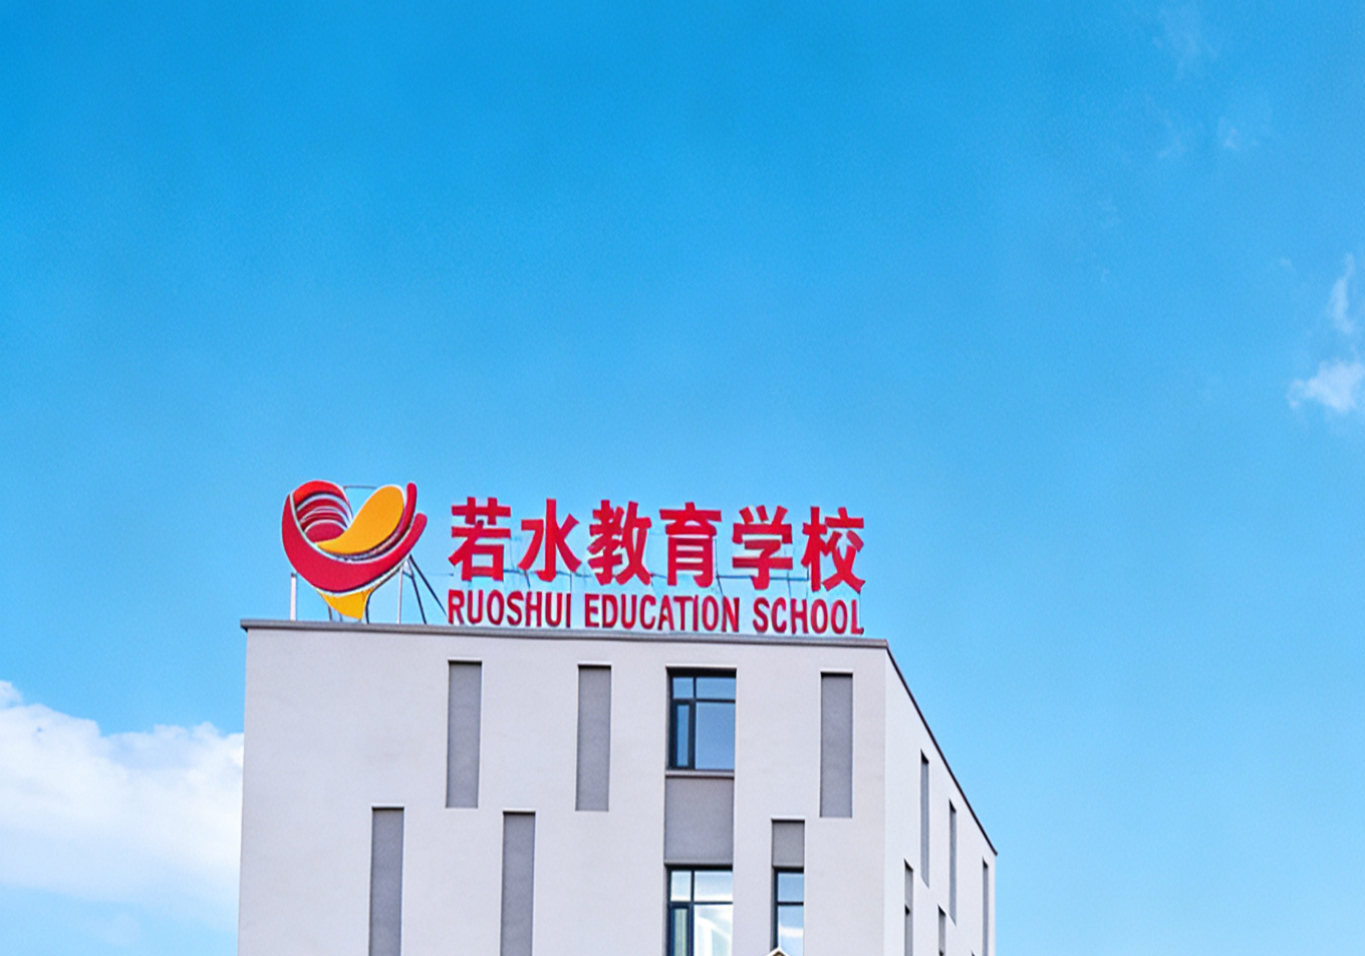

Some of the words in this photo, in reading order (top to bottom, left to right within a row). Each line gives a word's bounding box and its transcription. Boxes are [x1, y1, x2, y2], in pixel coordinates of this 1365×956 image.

[448, 496, 866, 594] 若水教育学校
[447, 589, 572, 628] RUOSHUI
[584, 593, 740, 633] EDUCATION
[752, 597, 865, 635] SCHOOL
